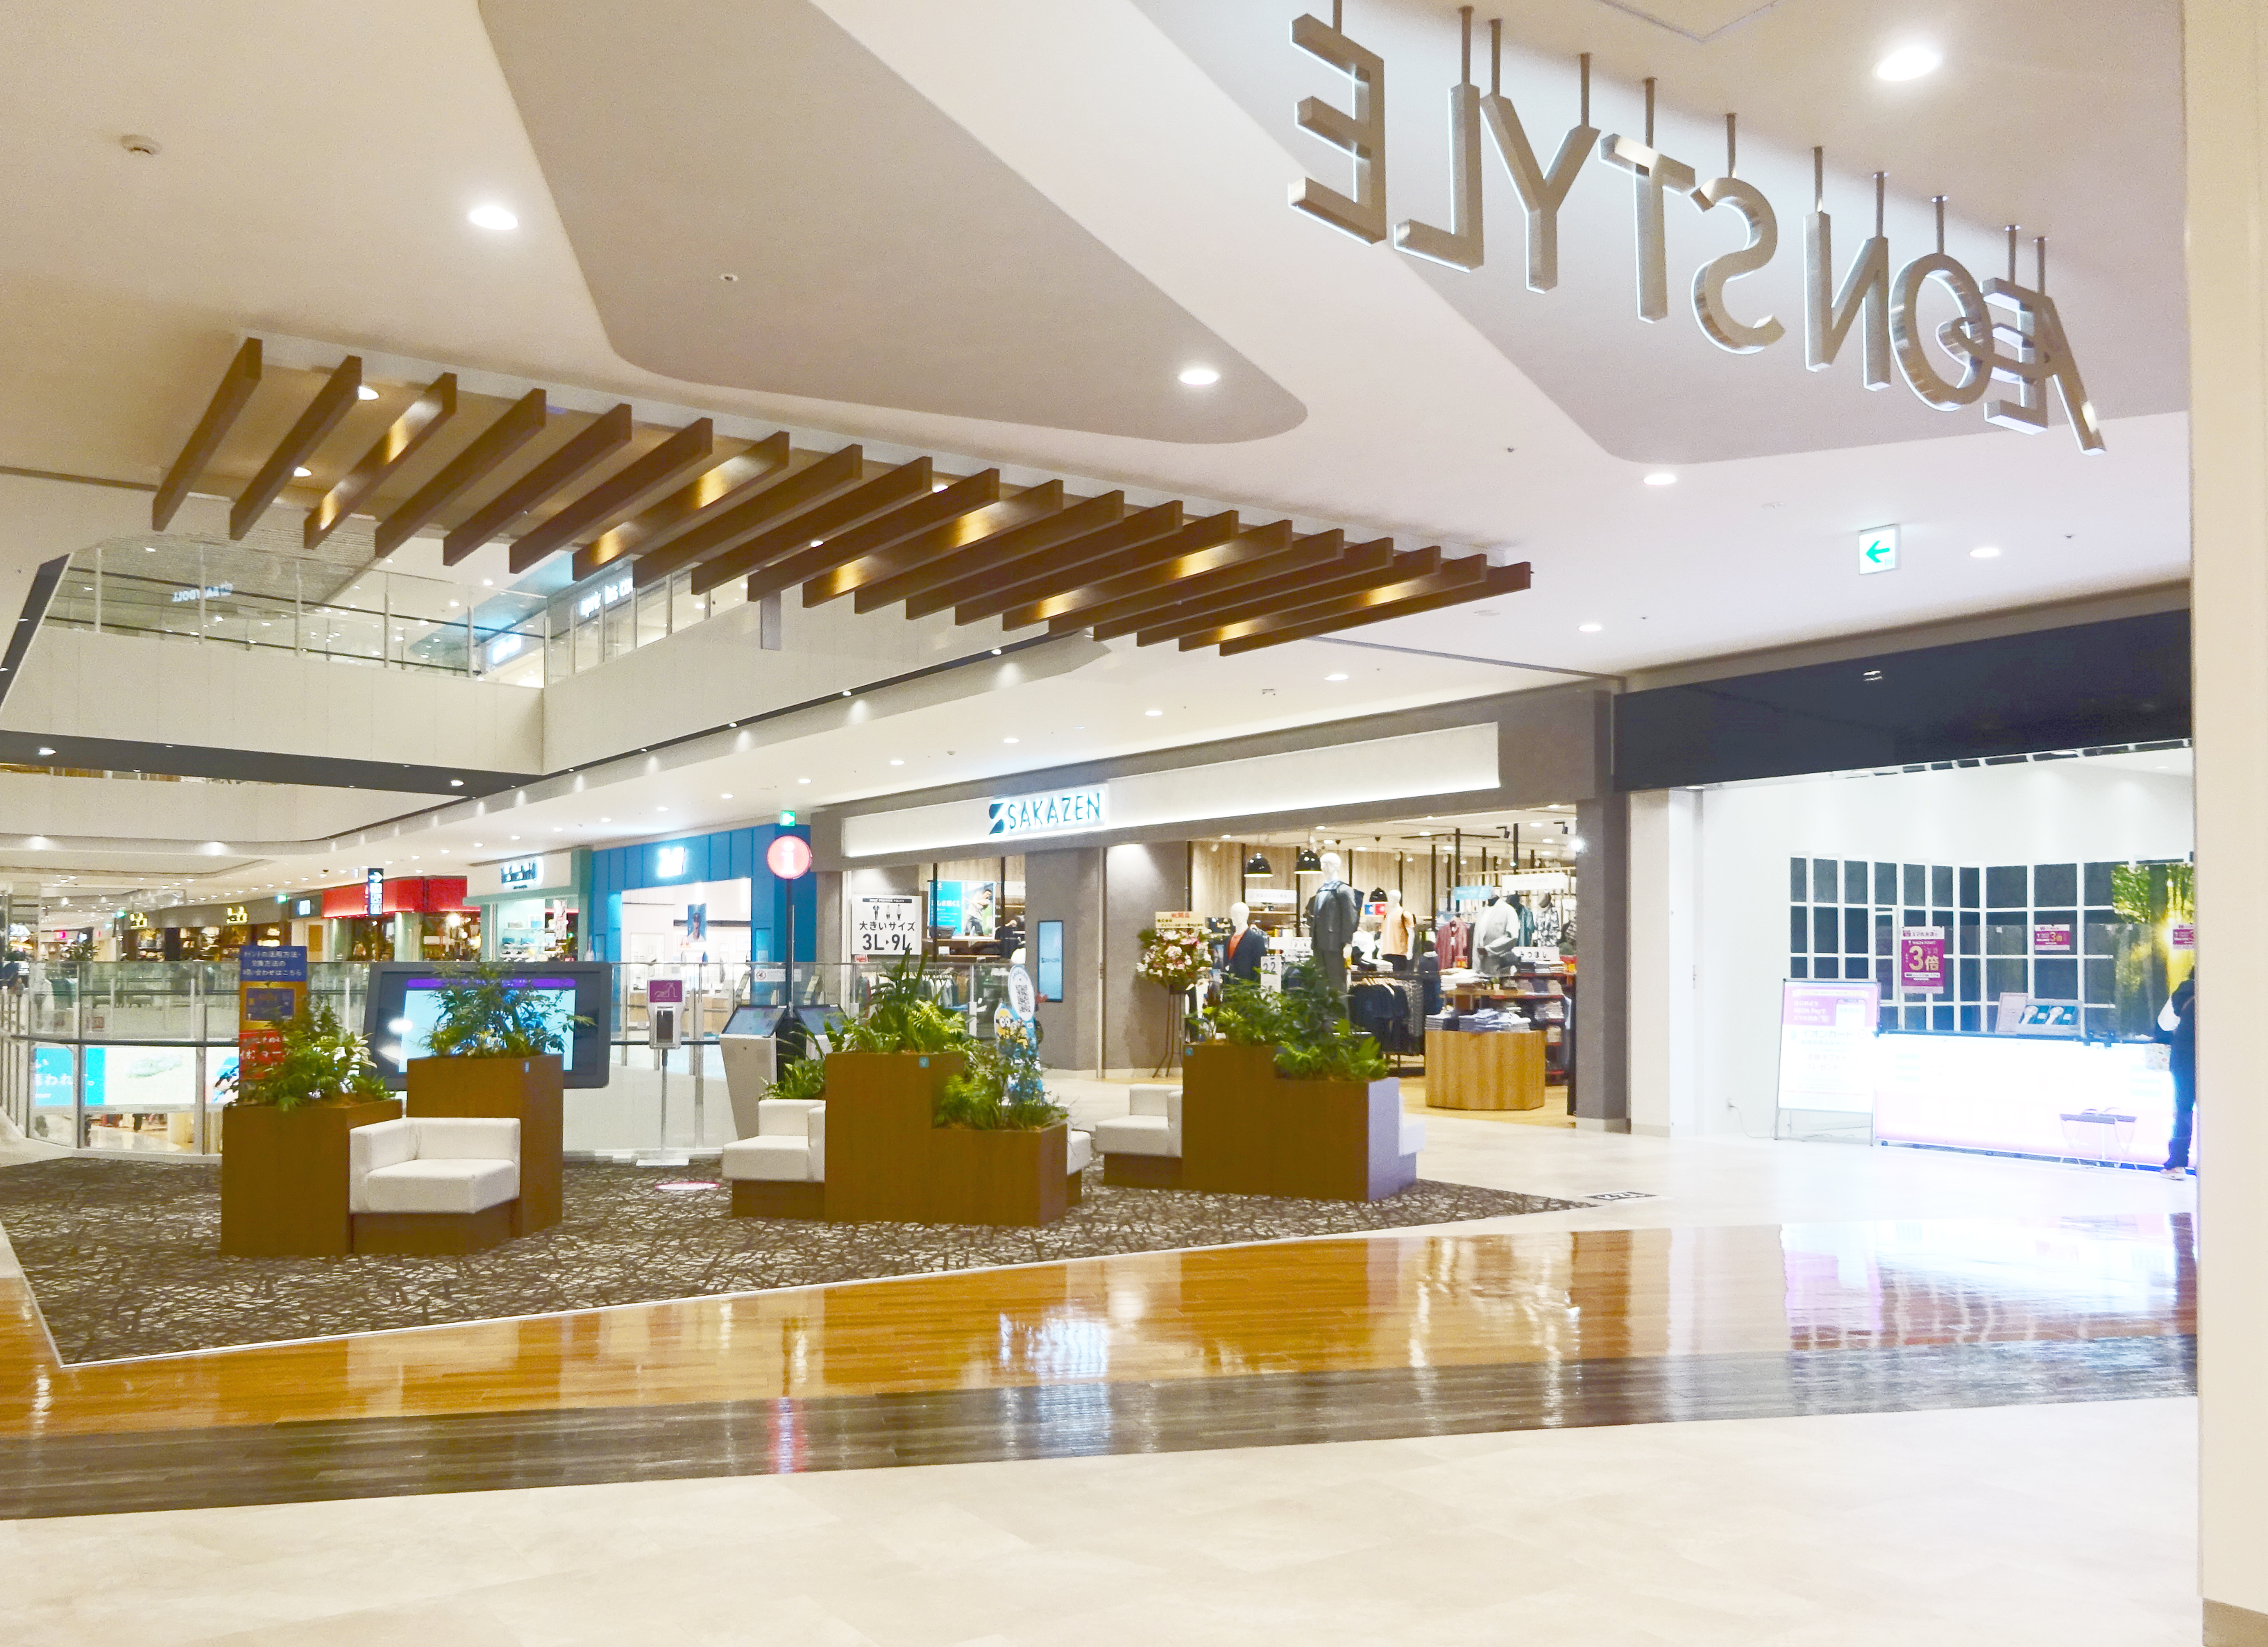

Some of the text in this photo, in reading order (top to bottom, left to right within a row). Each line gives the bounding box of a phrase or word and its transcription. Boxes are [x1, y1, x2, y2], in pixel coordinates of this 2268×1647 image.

[1008, 792, 1104, 829] SAKAZEN
[859, 920, 915, 931] 大きいサイズ
[1909, 945, 1940, 971] 3倍
